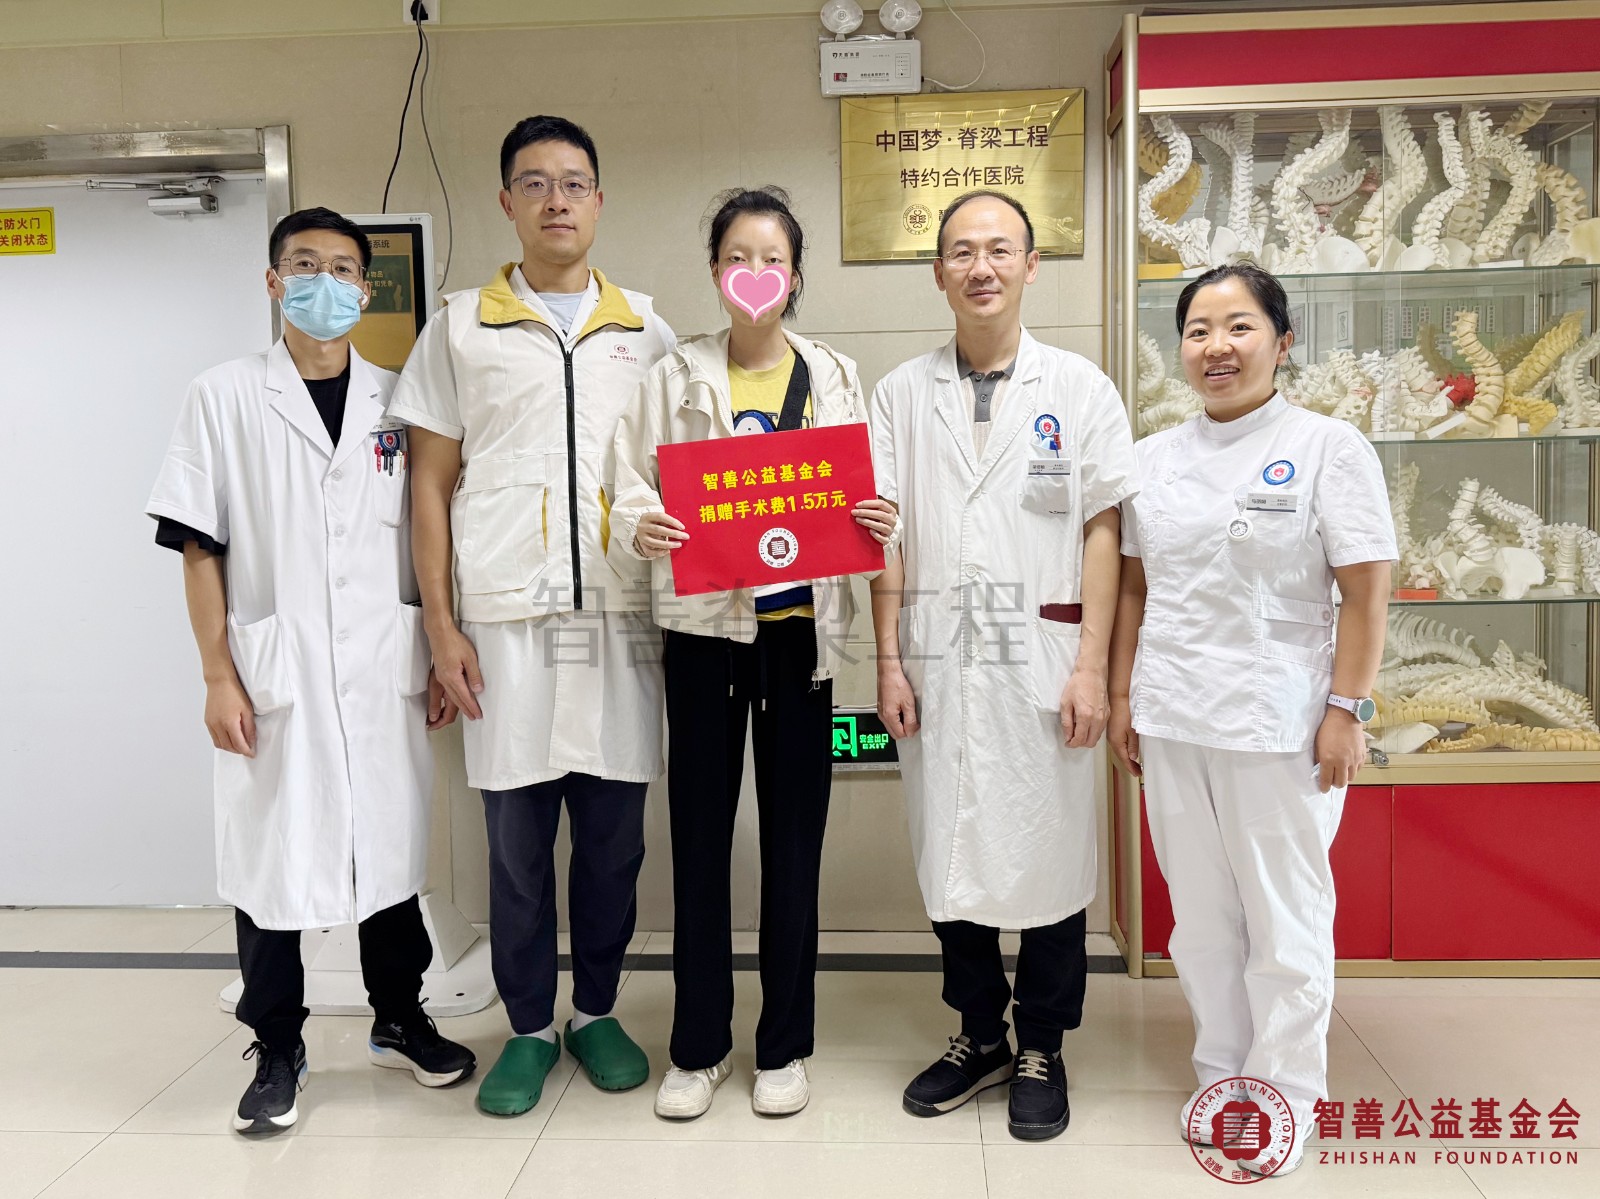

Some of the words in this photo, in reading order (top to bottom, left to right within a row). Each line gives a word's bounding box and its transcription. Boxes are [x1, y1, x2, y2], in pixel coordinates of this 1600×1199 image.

[875, 124, 1049, 153] 中国梦·脊梁工程
[900, 165, 1025, 189] 特约合作医院
[0, 217, 41, 231] 防火门
[702, 460, 833, 491] 智善公益基金会
[698, 489, 847, 524] 捐赠手术费1.5万元
[860, 733, 889, 743] 安全出口
